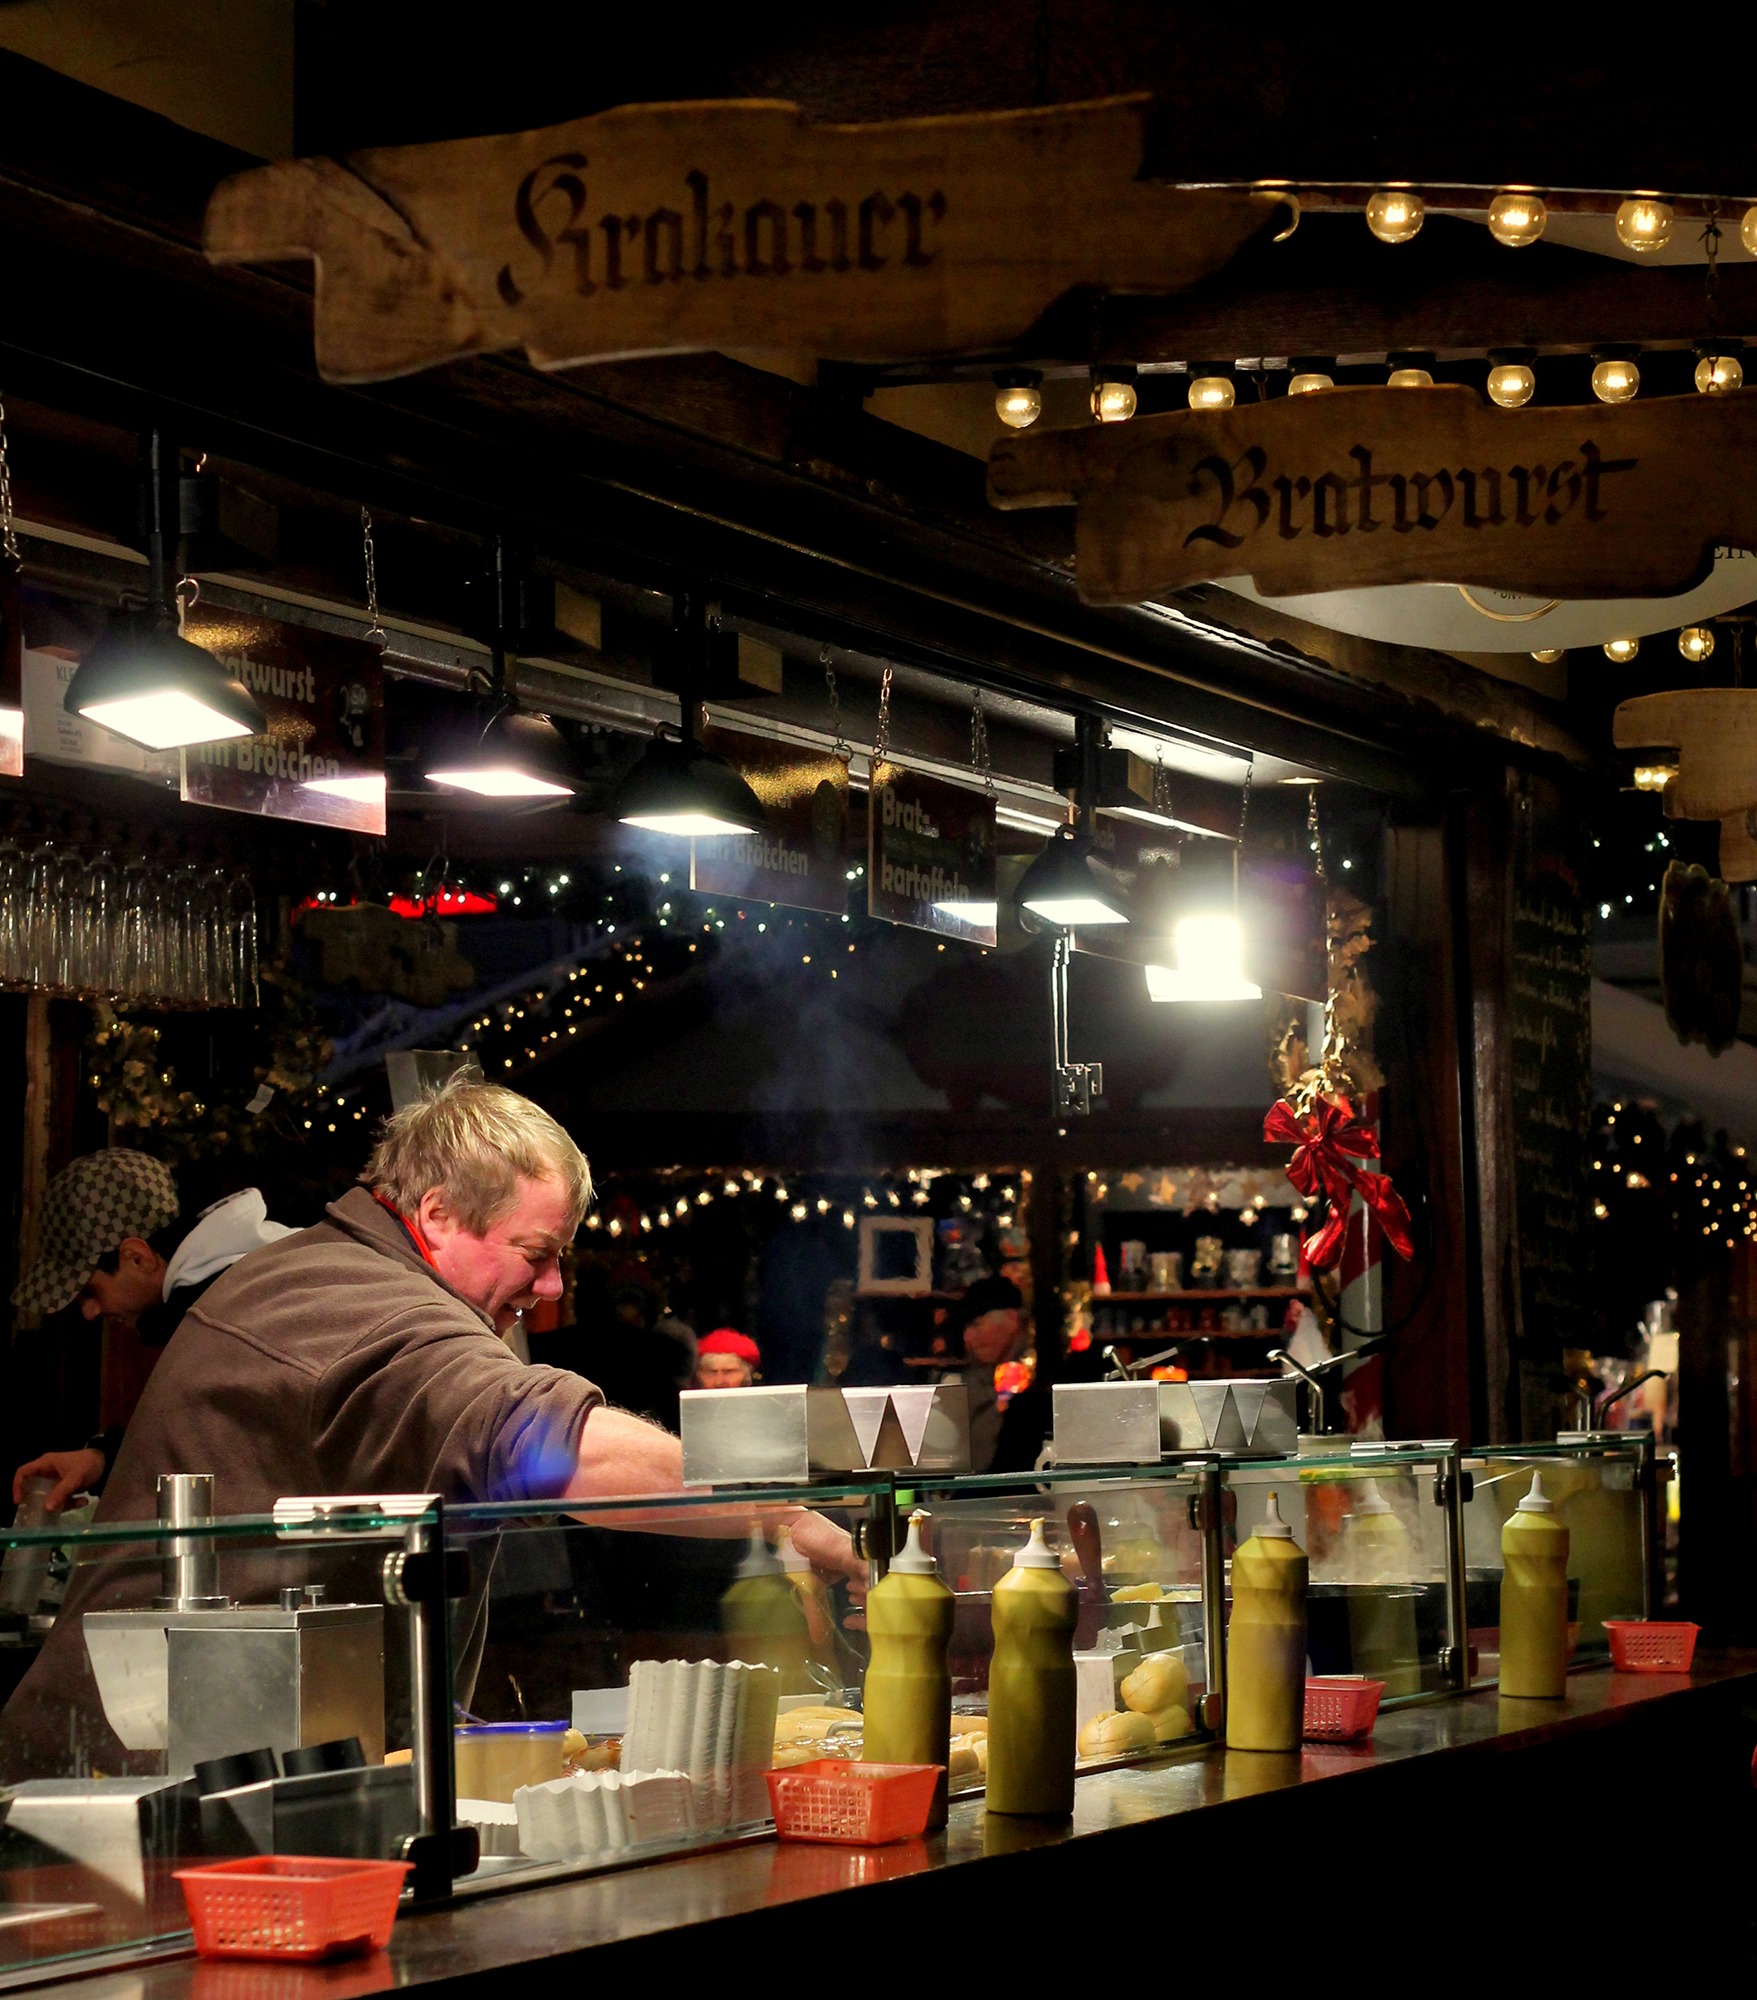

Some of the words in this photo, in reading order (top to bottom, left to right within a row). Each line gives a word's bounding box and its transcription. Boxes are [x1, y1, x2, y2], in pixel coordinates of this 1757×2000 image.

[496, 153, 946, 306] Krakauer
[1182, 439, 1639, 549] Bratwurst
[882, 785, 930, 834] Brat-
[734, 833, 808, 876] Brötchen
[881, 853, 970, 903] kartoffeln
